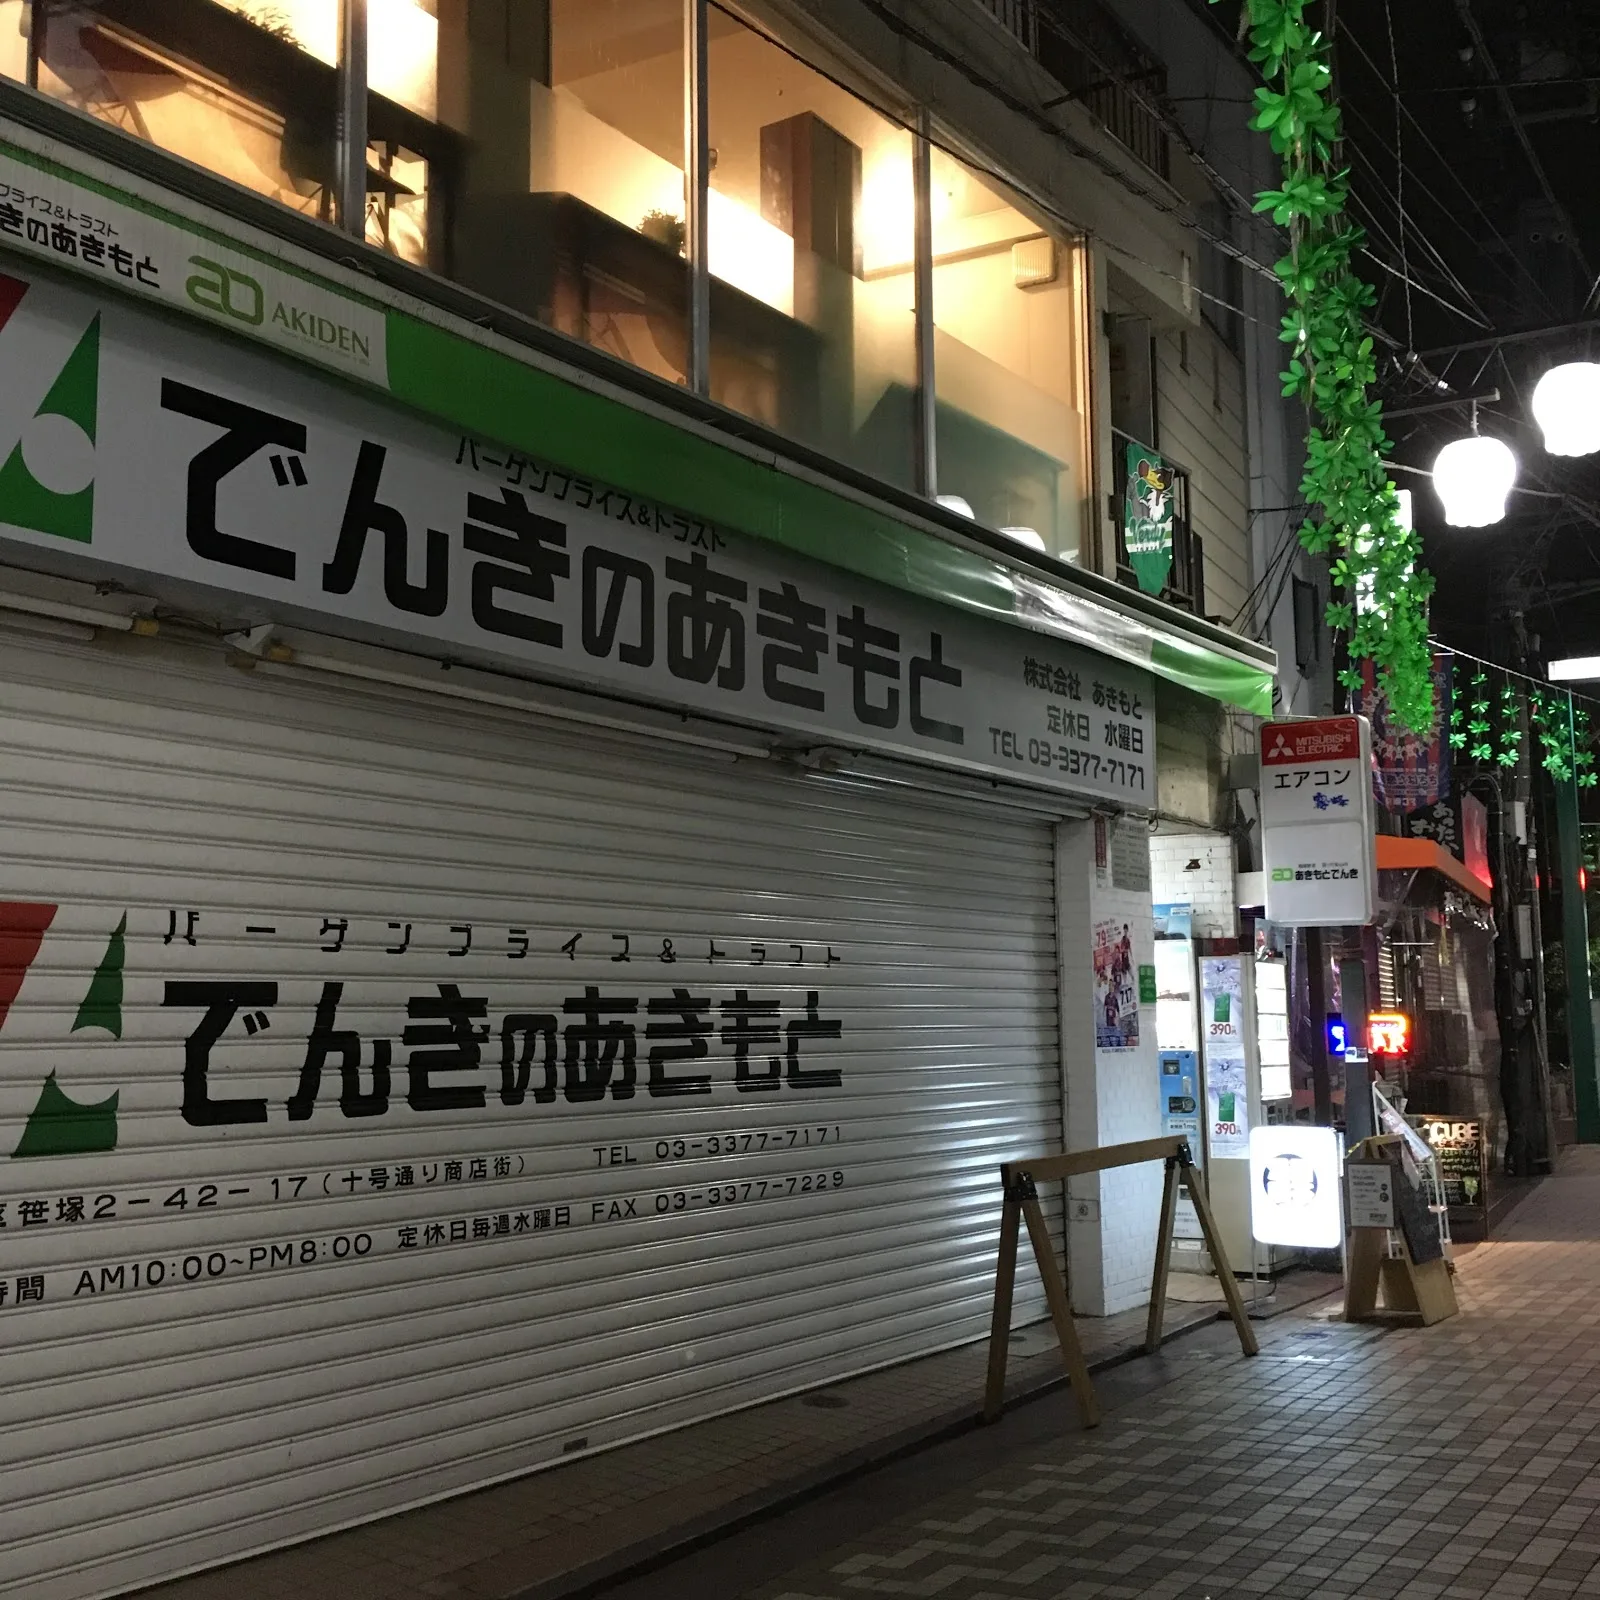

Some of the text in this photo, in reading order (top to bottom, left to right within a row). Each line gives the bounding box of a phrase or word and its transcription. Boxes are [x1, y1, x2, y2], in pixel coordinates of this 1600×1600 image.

[272, 301, 370, 358] AKIDEN
[160, 377, 964, 745] でんきのあきもと
[1023, 655, 1143, 720] 株式会社 あきもと
[1047, 704, 1144, 754] 定休日 水曜日
[1295, 734, 1351, 746] MITSUBISHI
[1296, 744, 1344, 756] ELECTRIC
[988, 727, 1145, 790] TEL 03-3377-7171
[1274, 770, 1351, 789] エアコン
[1295, 868, 1359, 881] あきもとでんき
[160, 981, 843, 1127] でんきのあきもと
[593, 1145, 637, 1167] TEL
[656, 1126, 843, 1159] 03-3377-7171
[398, 1206, 571, 1248] 定休日毎週水曜日
[592, 1198, 637, 1222] FAX
[656, 1171, 845, 1213] 03-3377-7229
